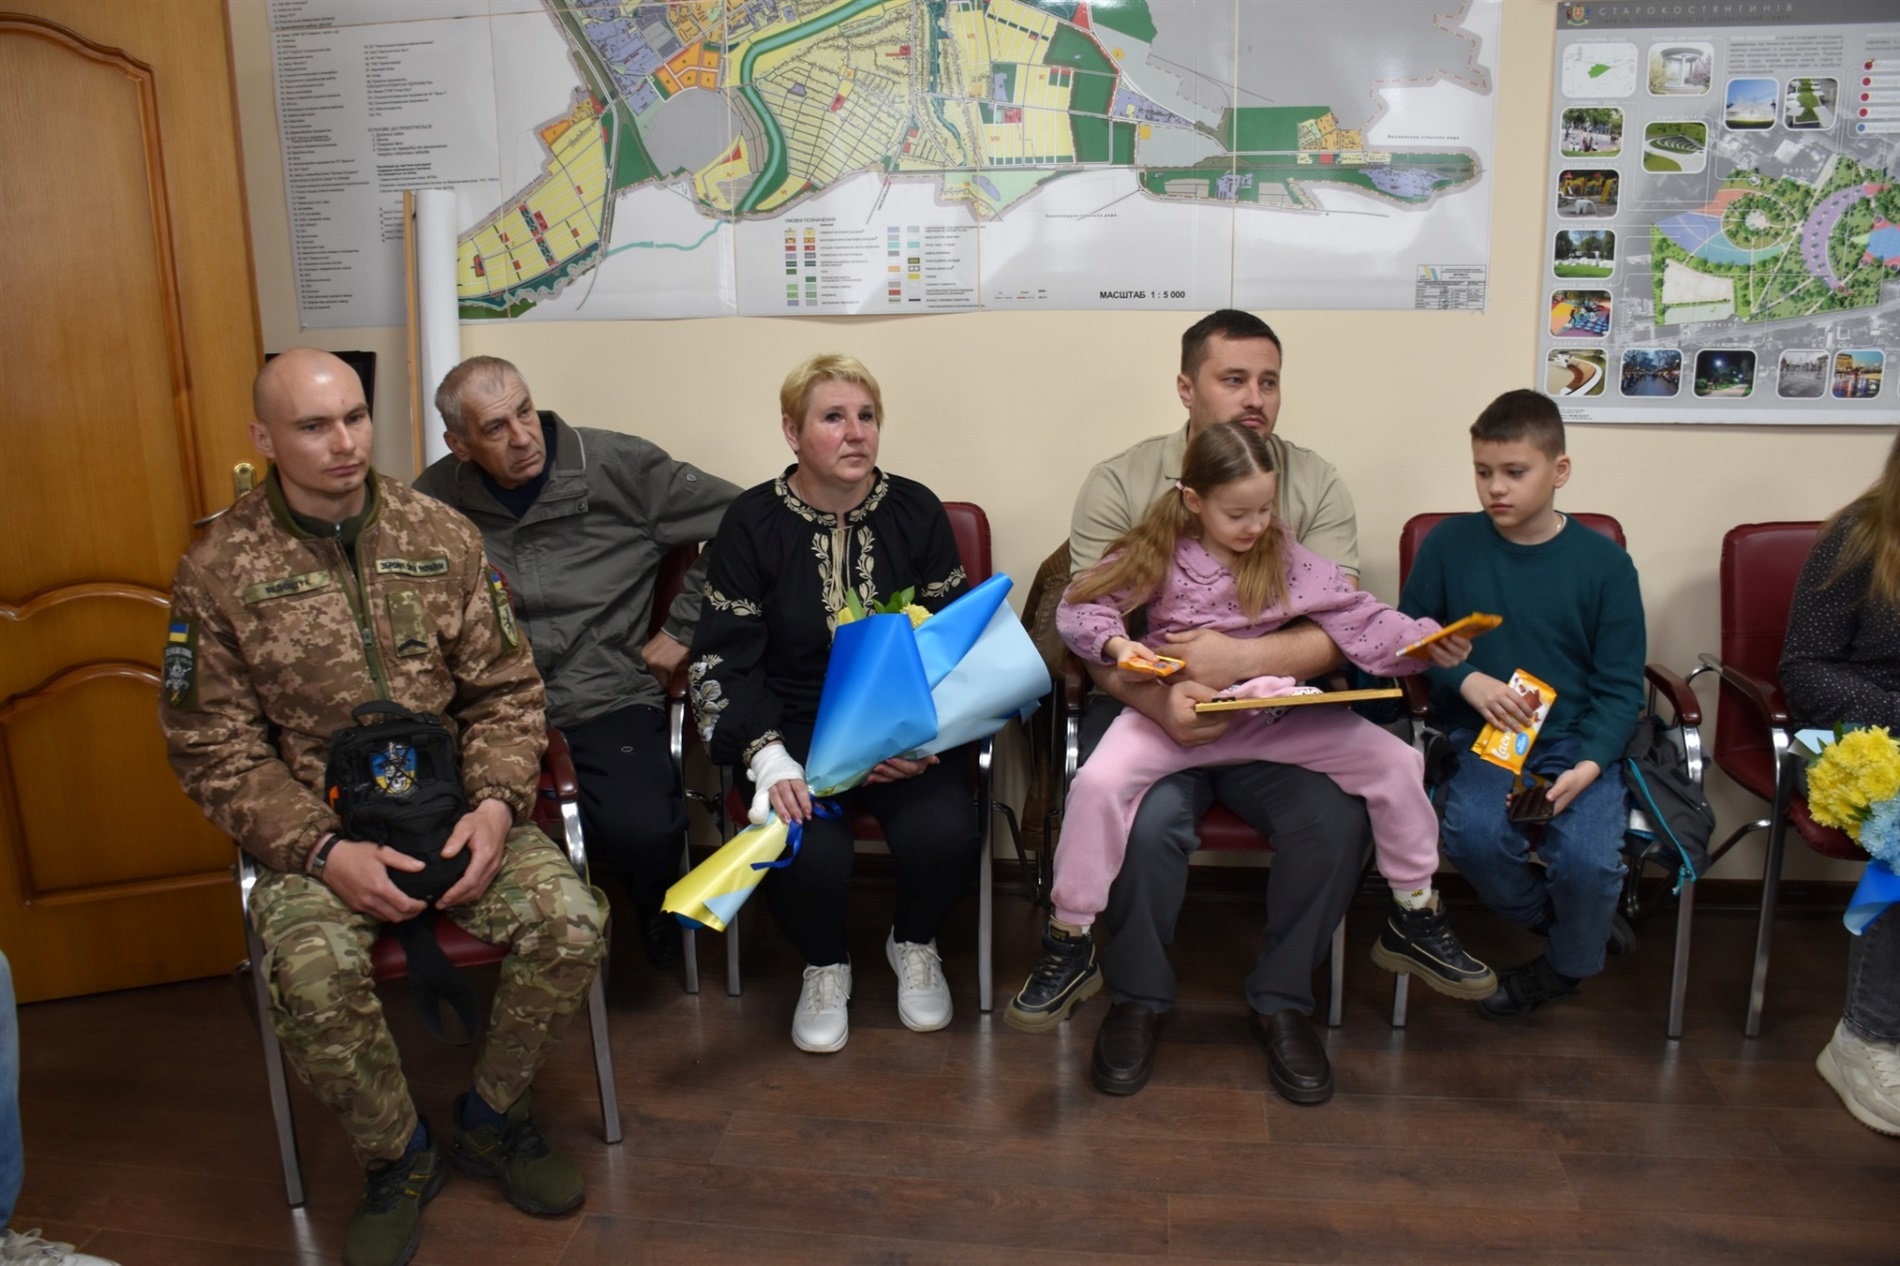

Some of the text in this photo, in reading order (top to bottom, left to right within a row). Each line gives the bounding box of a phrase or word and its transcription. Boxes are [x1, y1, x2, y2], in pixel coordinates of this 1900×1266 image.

[1598, 4, 1793, 16] СТАРОКОСТЯНТИНІВ
[1099, 291, 1146, 299] МАСШТАБ
[1150, 291, 1155, 299] 1
[1163, 291, 1168, 299] 5
[1170, 291, 1186, 299] 000
